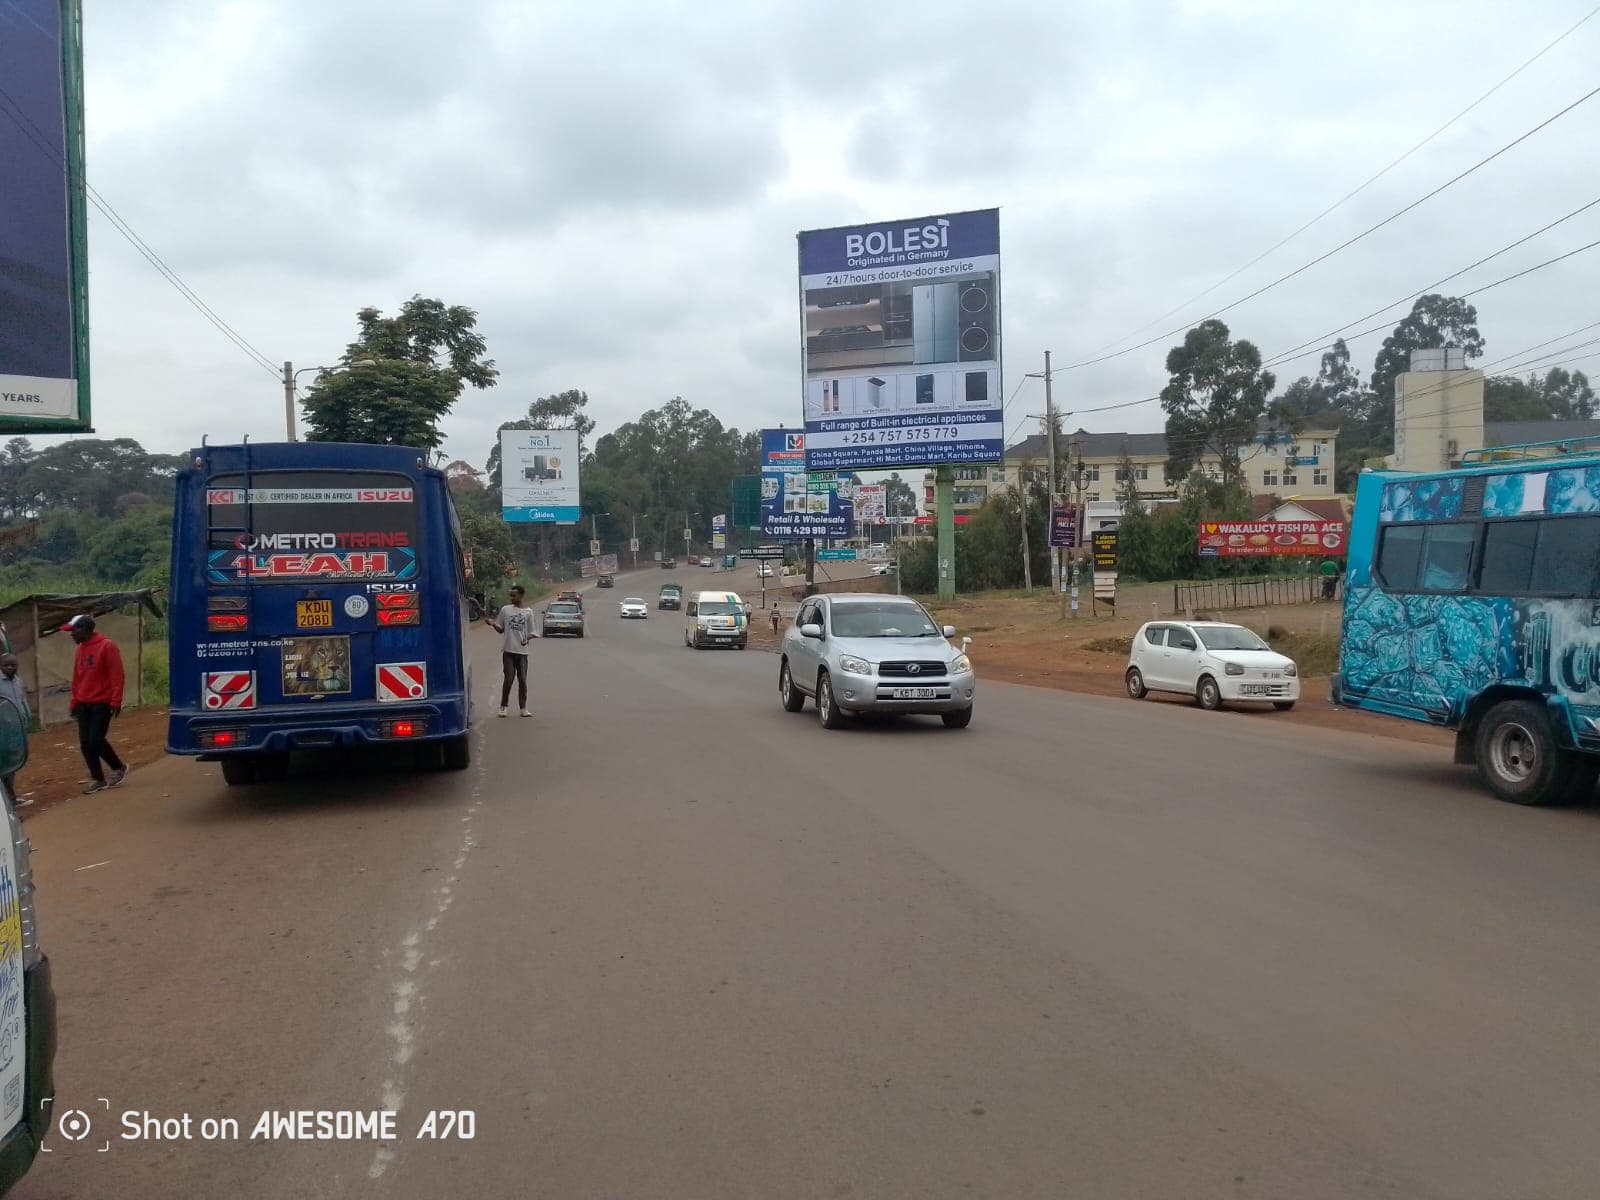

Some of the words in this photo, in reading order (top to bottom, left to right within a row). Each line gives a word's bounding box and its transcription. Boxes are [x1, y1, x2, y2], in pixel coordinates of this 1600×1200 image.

[846, 218, 950, 258] BOLESI
[847, 254, 895, 267] Originated
[896, 253, 905, 262] in
[907, 249, 950, 262] Germany
[826, 274, 849, 286] 24/7
[850, 271, 876, 283] hours
[878, 267, 938, 281] door-to-door
[939, 261, 974, 273] service
[2, 393, 44, 404] YEARS.
[820, 421, 836, 431] Full
[837, 420, 860, 432] range
[861, 419, 870, 428] of
[871, 417, 901, 428] Built-in
[901, 414, 939, 426] electrical
[941, 412, 986, 424] appliances
[843, 433, 875, 444] +254
[880, 430, 902, 442] 757
[907, 428, 930, 440] 575
[934, 426, 958, 438] 779
[811, 450, 832, 459] China
[861, 448, 884, 457] Panda
[904, 445, 926, 454] China
[811, 458, 834, 467] Global
[876, 455, 884, 463] Hi
[904, 453, 926, 462] Dumu
[947, 450, 973, 460] Karibu
[973, 449, 1001, 459] Square
[238, 493, 254, 501] FIST
[270, 492, 299, 501] CERTIFIED
[300, 492, 323, 500] DEALER
[323, 492, 331, 500] IN
[332, 492, 353, 500] AFRICA
[357, 490, 413, 501] ISUZU
[768, 515, 793, 524] Retail
[794, 515, 801, 524] &
[802, 515, 846, 524] Wholesale
[773, 526, 793, 535] 0116
[1218, 524, 1276, 534] WAKALUCY
[1278, 523, 1301, 533] FISH
[230, 552, 388, 578] LEAH
[366, 583, 417, 594] ISUZU
[305, 602, 329, 614] KDU
[352, 601, 361, 610] 80
[196, 639, 294, 650] ww.metrotans.co.ke
